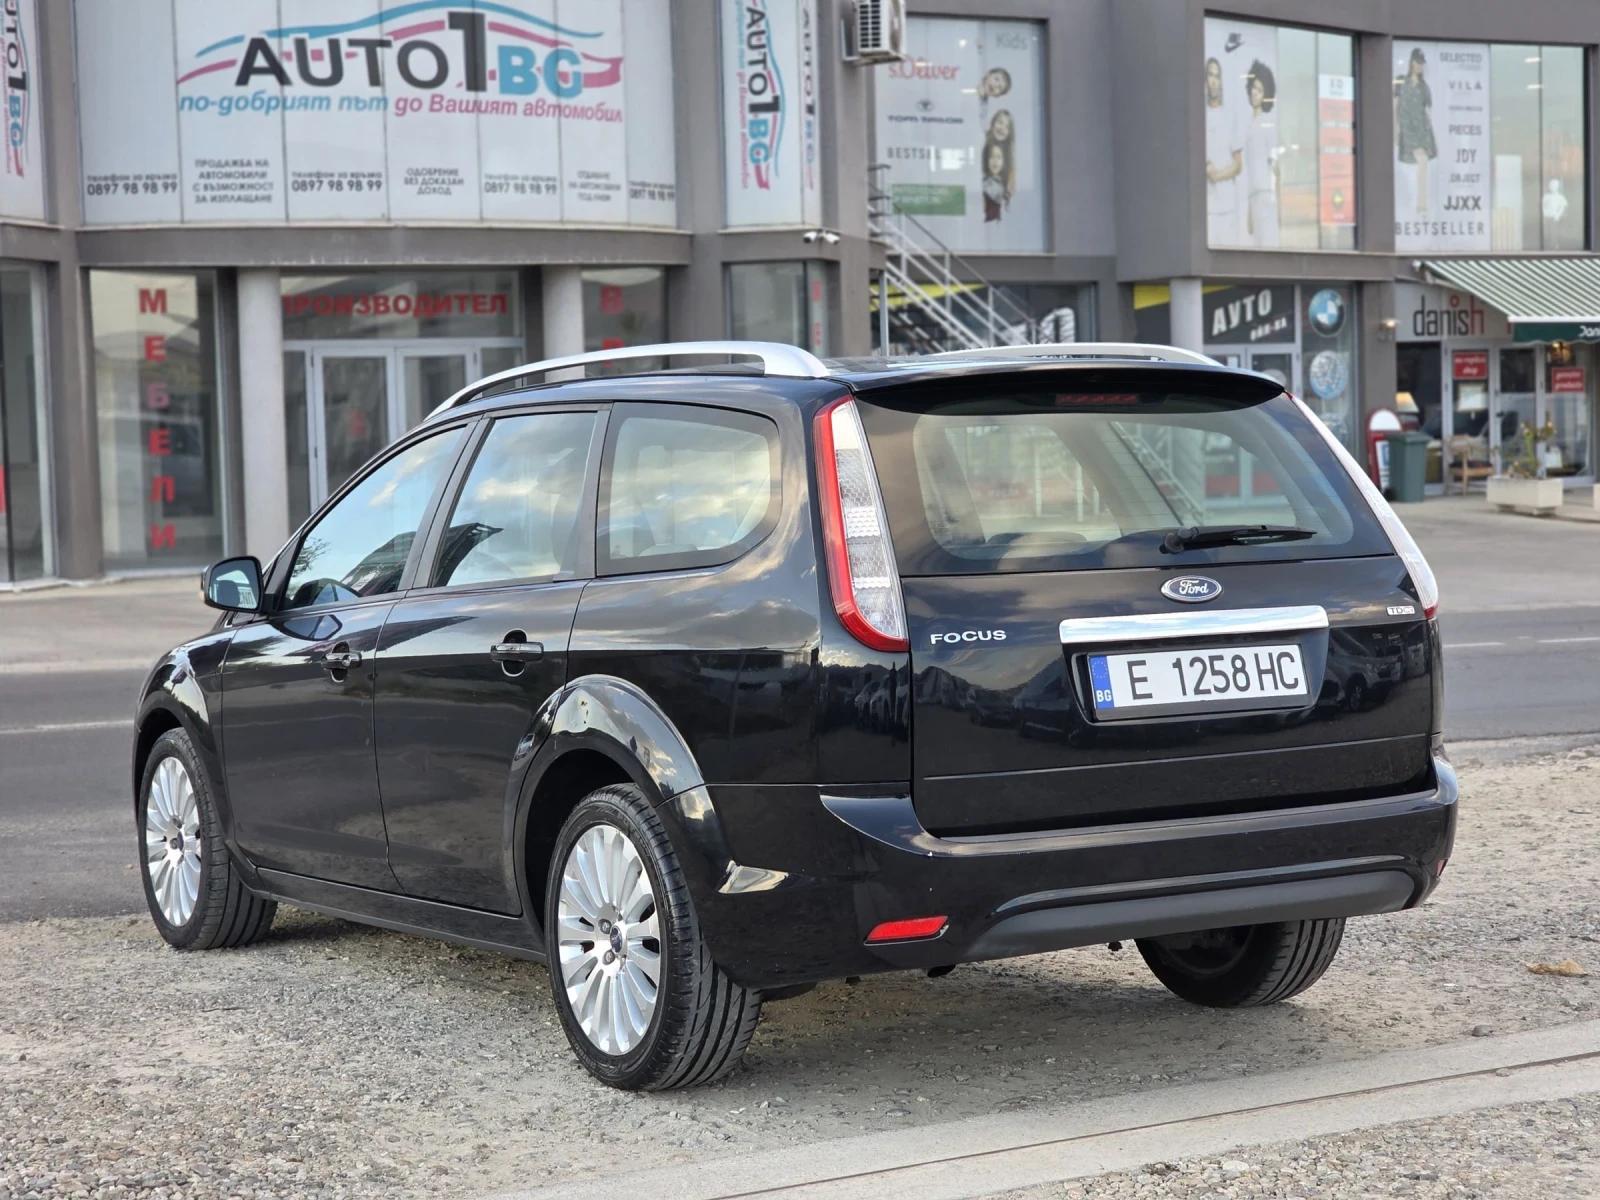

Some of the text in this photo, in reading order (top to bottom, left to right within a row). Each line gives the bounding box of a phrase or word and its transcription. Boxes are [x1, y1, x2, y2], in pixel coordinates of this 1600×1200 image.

[1440, 52, 1482, 63] SELECTED
[1448, 80, 1482, 91] VILA
[179, 89, 623, 123] по-добрият път до Вашият автомобил
[1448, 124, 1482, 136] PIECES
[1456, 148, 1477, 163] JDY
[406, 167, 459, 177] ОДОБРЕНИЕ
[87, 181, 178, 196] 0897 98 98 99
[291, 179, 382, 192] 0897 98 98 99
[404, 177, 464, 186] БЕЗ ДОКАЗАН
[484, 182, 510, 194] 0897
[514, 183, 526, 194] 98
[545, 183, 558, 195] 99
[416, 187, 452, 196] ДОХОД
[1444, 195, 1482, 211] JJXX
[1395, 221, 1485, 236] BESTSELLER
[1413, 293, 1484, 337] danish
[1179, 580, 1209, 595] Ford
[930, 629, 1007, 645] FOCUS
[1127, 650, 1299, 701] E 1258 HC
[1096, 689, 1112, 702] BG
